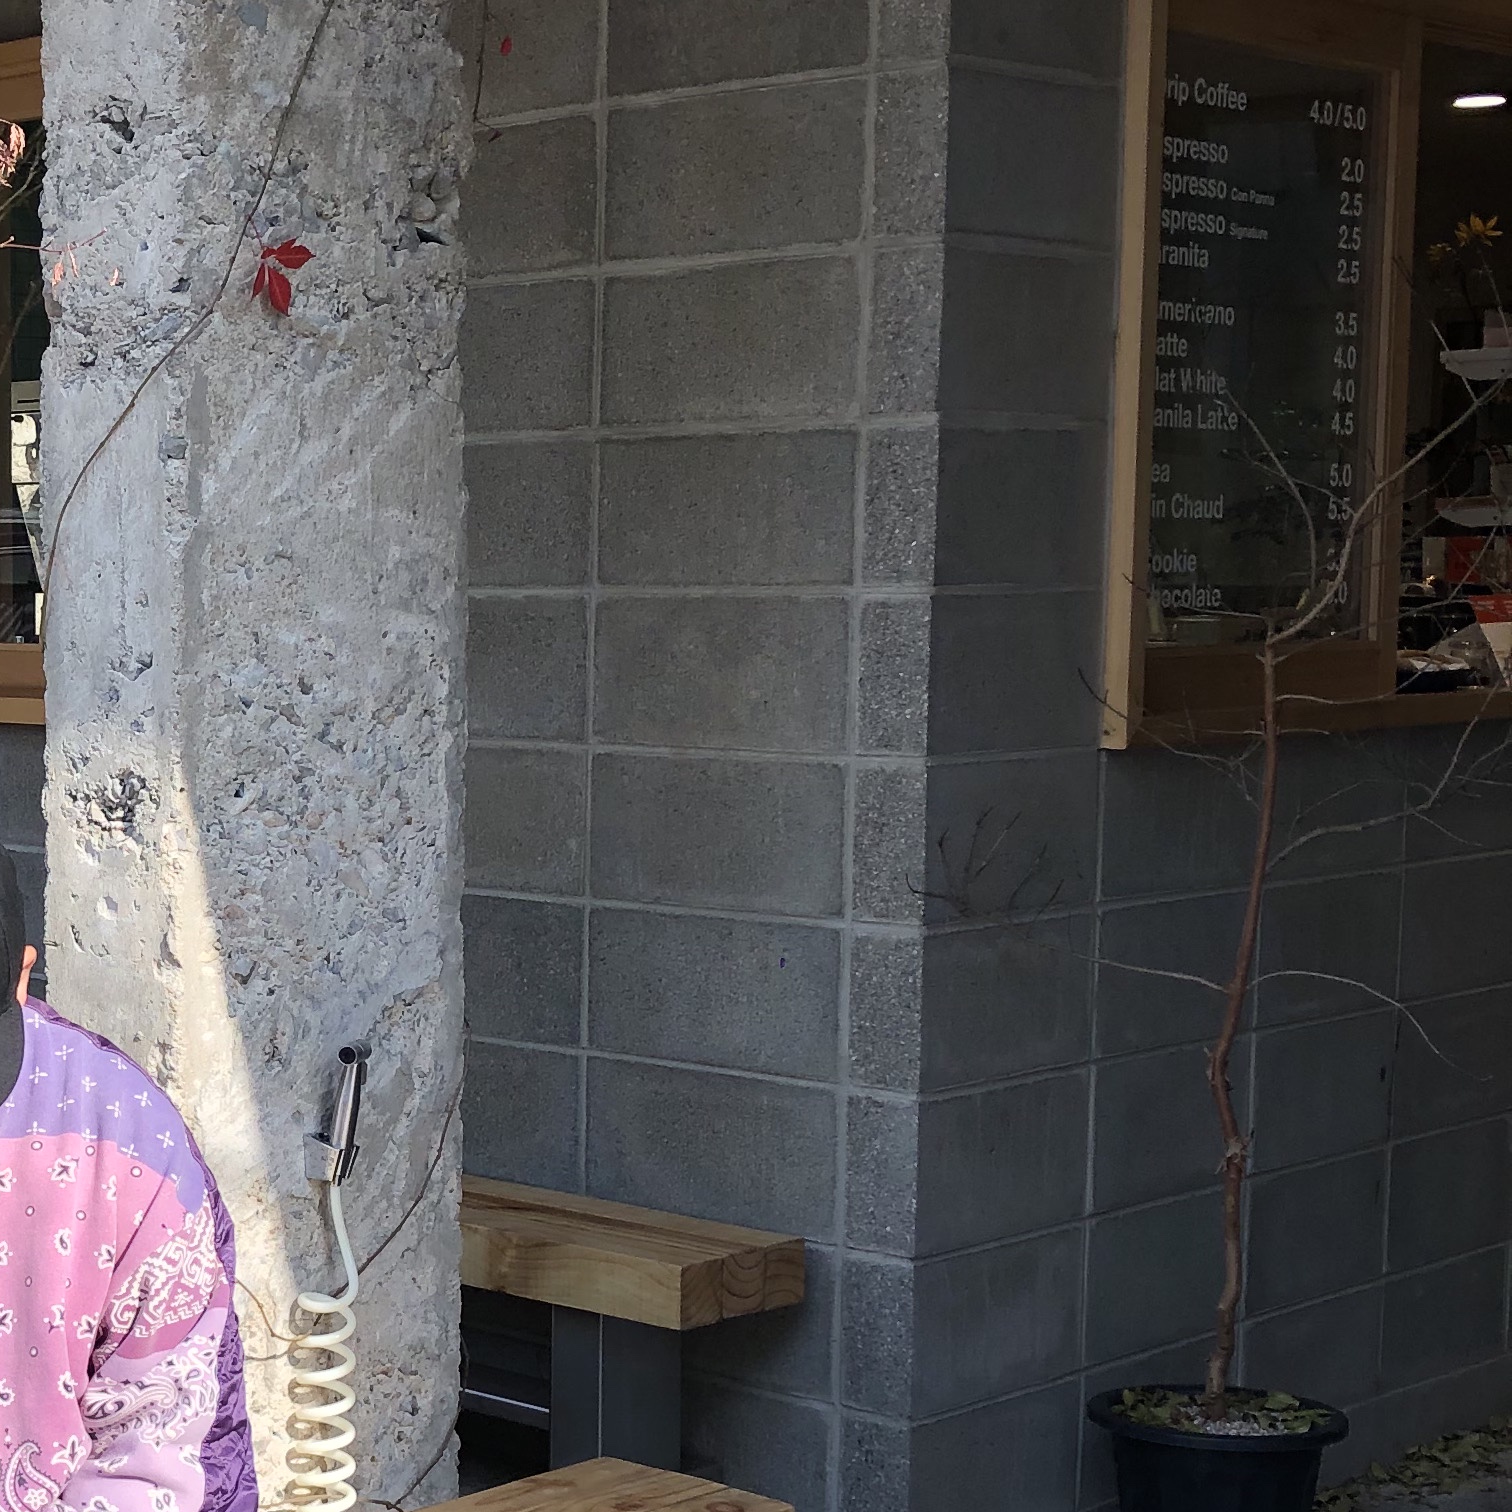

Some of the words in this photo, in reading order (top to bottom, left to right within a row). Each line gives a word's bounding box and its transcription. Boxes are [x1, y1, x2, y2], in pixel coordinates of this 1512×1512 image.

[1167, 74, 1189, 106] rip
[1194, 78, 1248, 111] Coffee
[1310, 100, 1366, 131] 4.0/5.0
[1163, 135, 1228, 164] spresso
[1341, 157, 1364, 183] 2.0
[1162, 172, 1227, 199] spresso
[1340, 192, 1363, 217] 2.5
[1161, 208, 1225, 235] spresso
[1338, 225, 1361, 250] 2.5
[1159, 242, 1209, 268] ranita
[1337, 259, 1359, 284] 2.5
[1158, 298, 1235, 326] mericano
[1335, 312, 1358, 336] 3.5
[1156, 333, 1188, 357] atte
[1334, 346, 1356, 369] 4.0
[1156, 366, 1175, 393] lat
[1180, 367, 1227, 394] White
[1333, 379, 1355, 403] 4.0
[1154, 403, 1192, 428] anila
[1331, 412, 1354, 435] 4.5
[1152, 463, 1170, 483] ea
[1329, 463, 1352, 487] 5.0
[1152, 494, 1166, 518] in
[1171, 493, 1224, 519] Chaud
[1328, 496, 1350, 520] 5.5
[1152, 549, 1197, 572] ookie
[1152, 584, 1222, 608] hocolate
